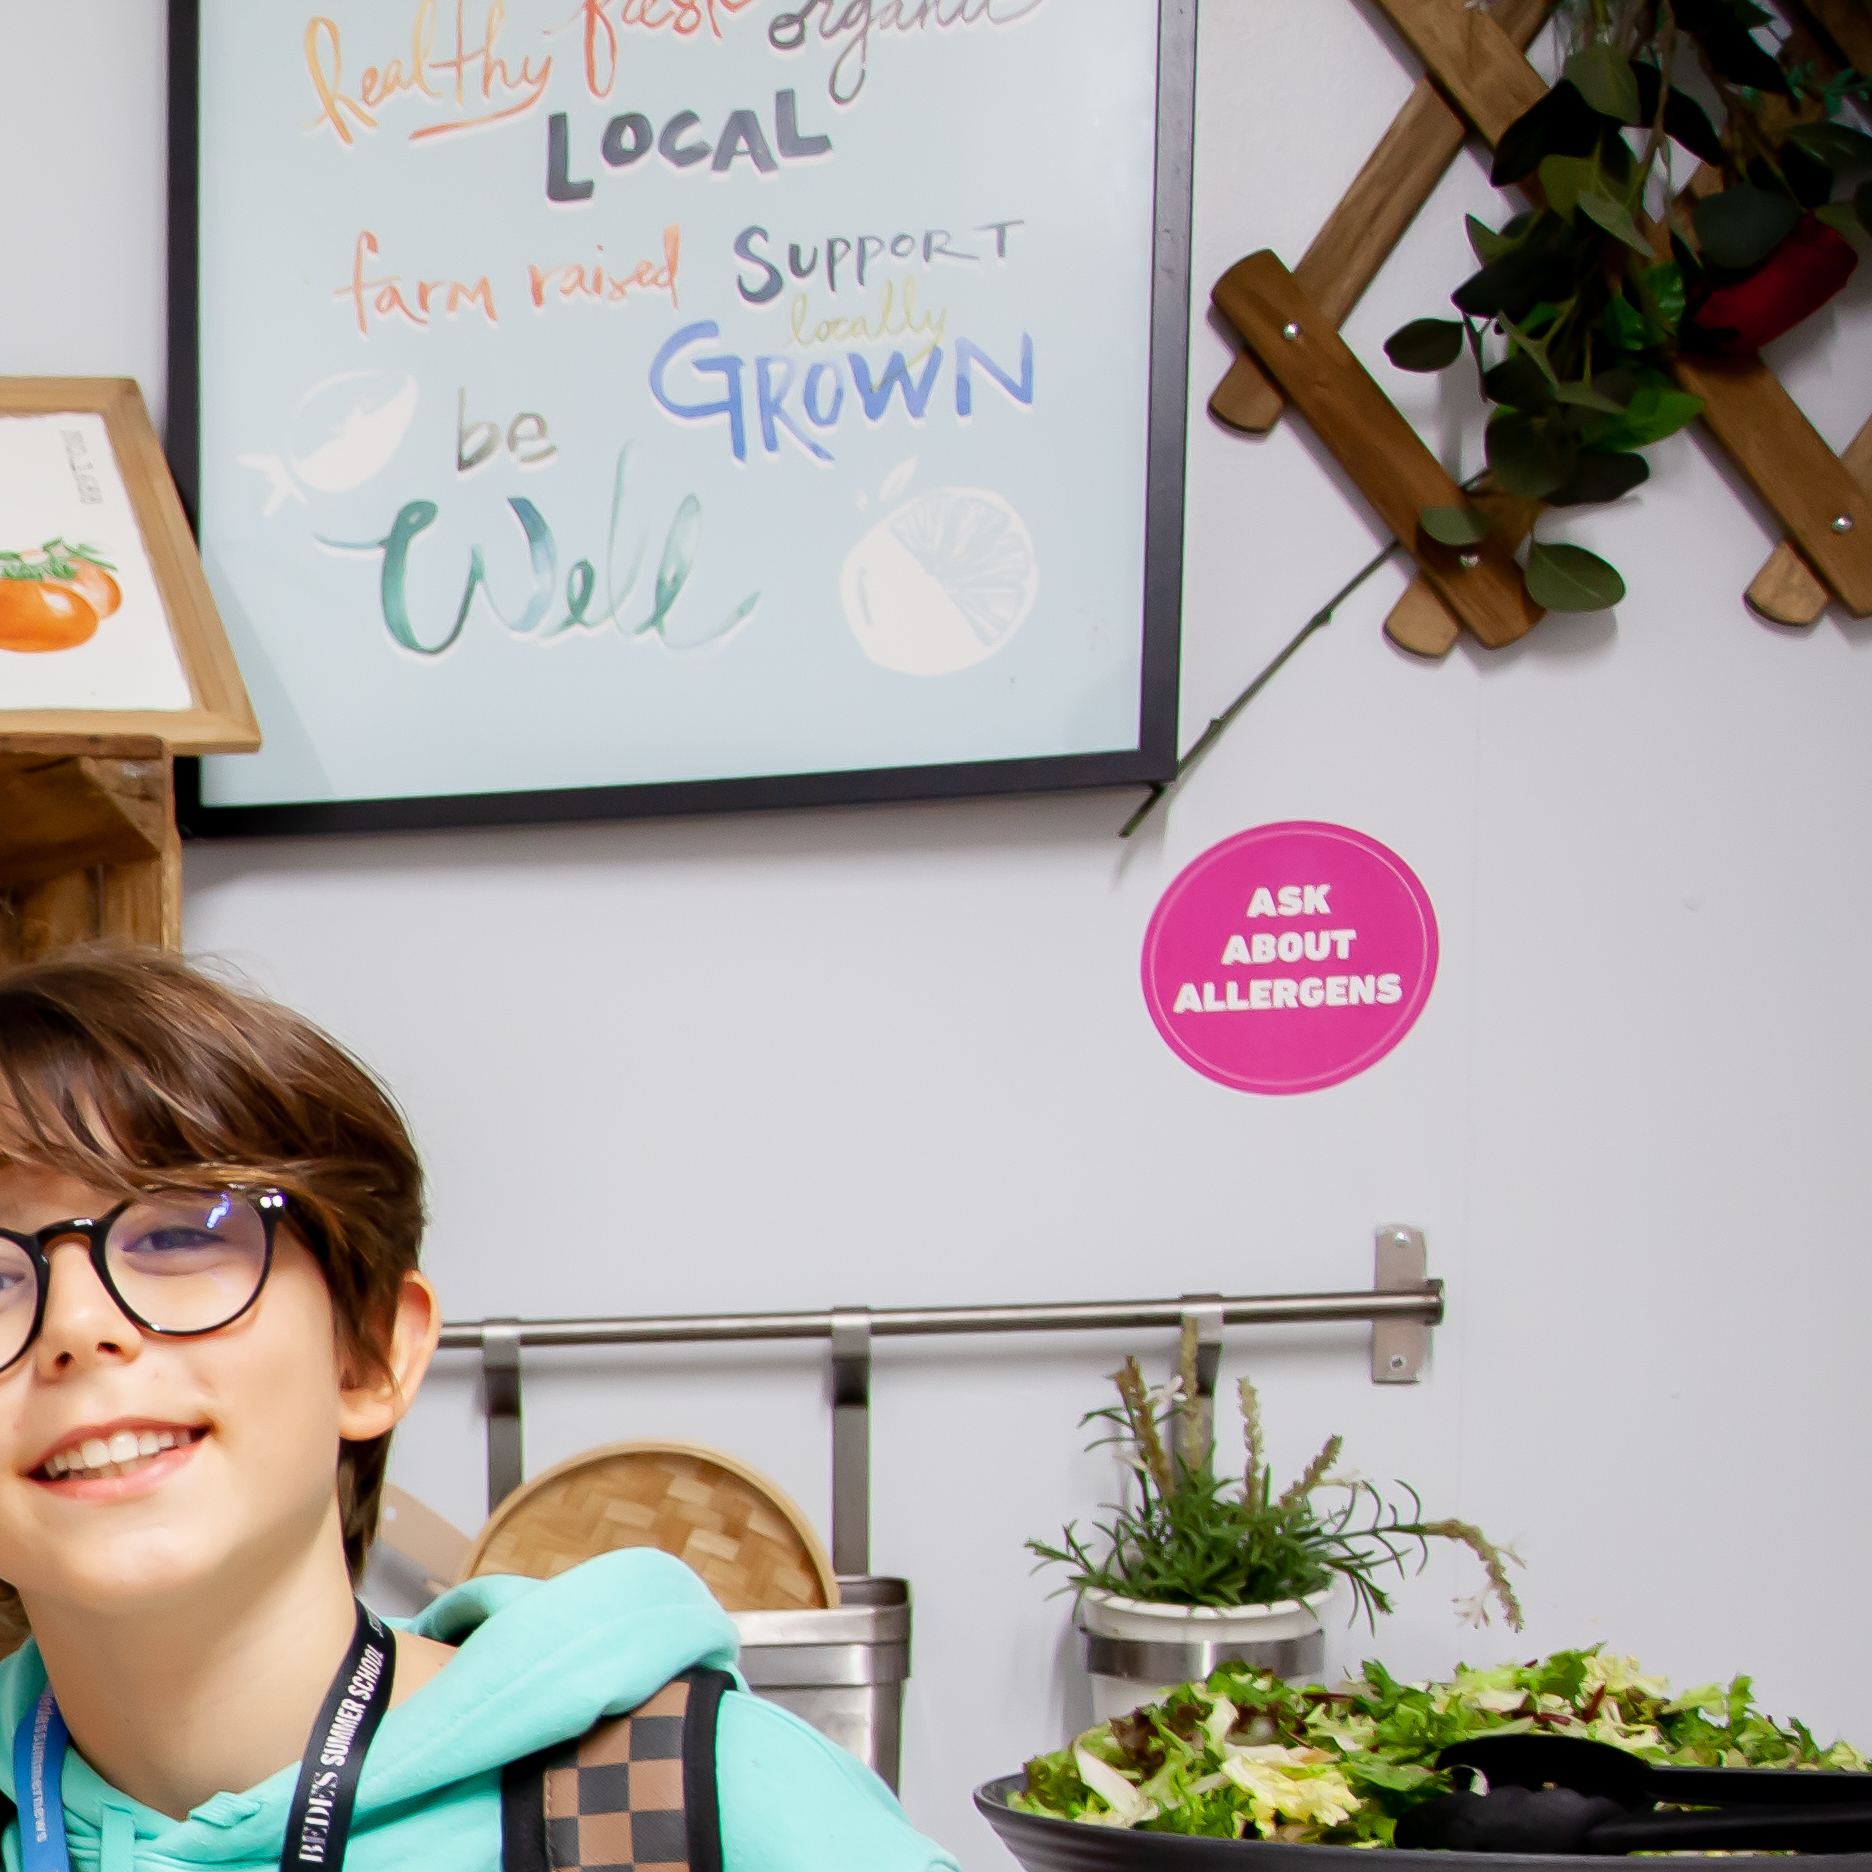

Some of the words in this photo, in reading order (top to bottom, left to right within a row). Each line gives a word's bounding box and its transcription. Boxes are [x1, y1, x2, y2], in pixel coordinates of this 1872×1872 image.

[302, 0, 552, 140] healthy
[547, 88, 832, 202] LOCAL
[333, 230, 498, 333] farm
[530, 225, 682, 309] raised
[734, 222, 1024, 304] SUPPORT
[789, 276, 946, 393] locally
[455, 388, 558, 472] be
[648, 320, 1034, 463] GROWN
[316, 438, 761, 656] Well
[1220, 928, 1357, 966] ABOUT
[1245, 884, 1332, 918] ASK
[1172, 974, 1404, 1014] ALLERGENS
[320, 1697, 367, 1767] SUMMER
[347, 1643, 386, 1701] SCHOOL
